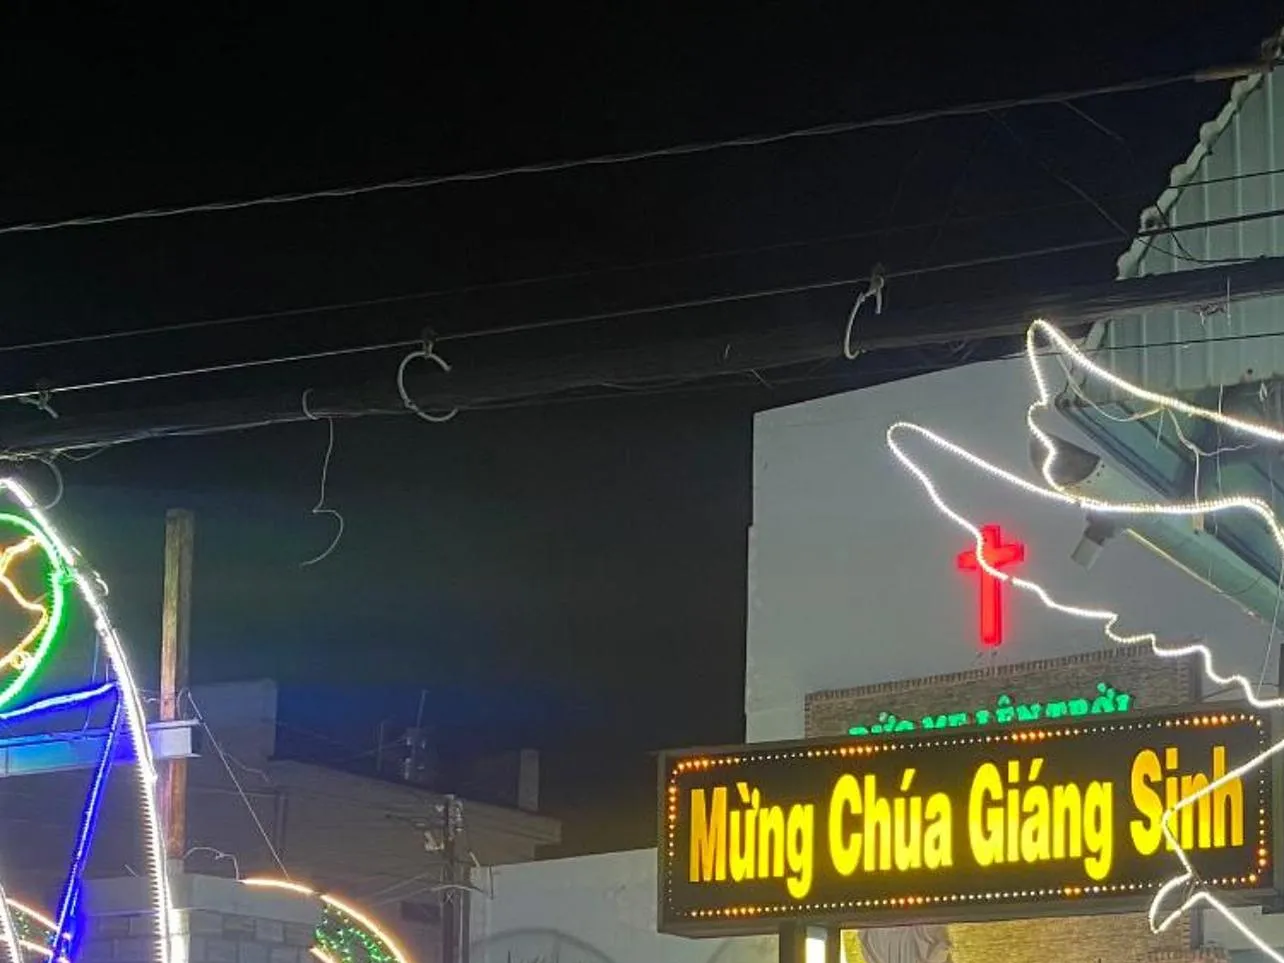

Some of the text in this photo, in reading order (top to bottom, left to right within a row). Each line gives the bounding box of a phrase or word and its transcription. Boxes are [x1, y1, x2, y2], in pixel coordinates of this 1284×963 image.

[690, 745, 1244, 899] Mừng Chúa Giáng Sinh
